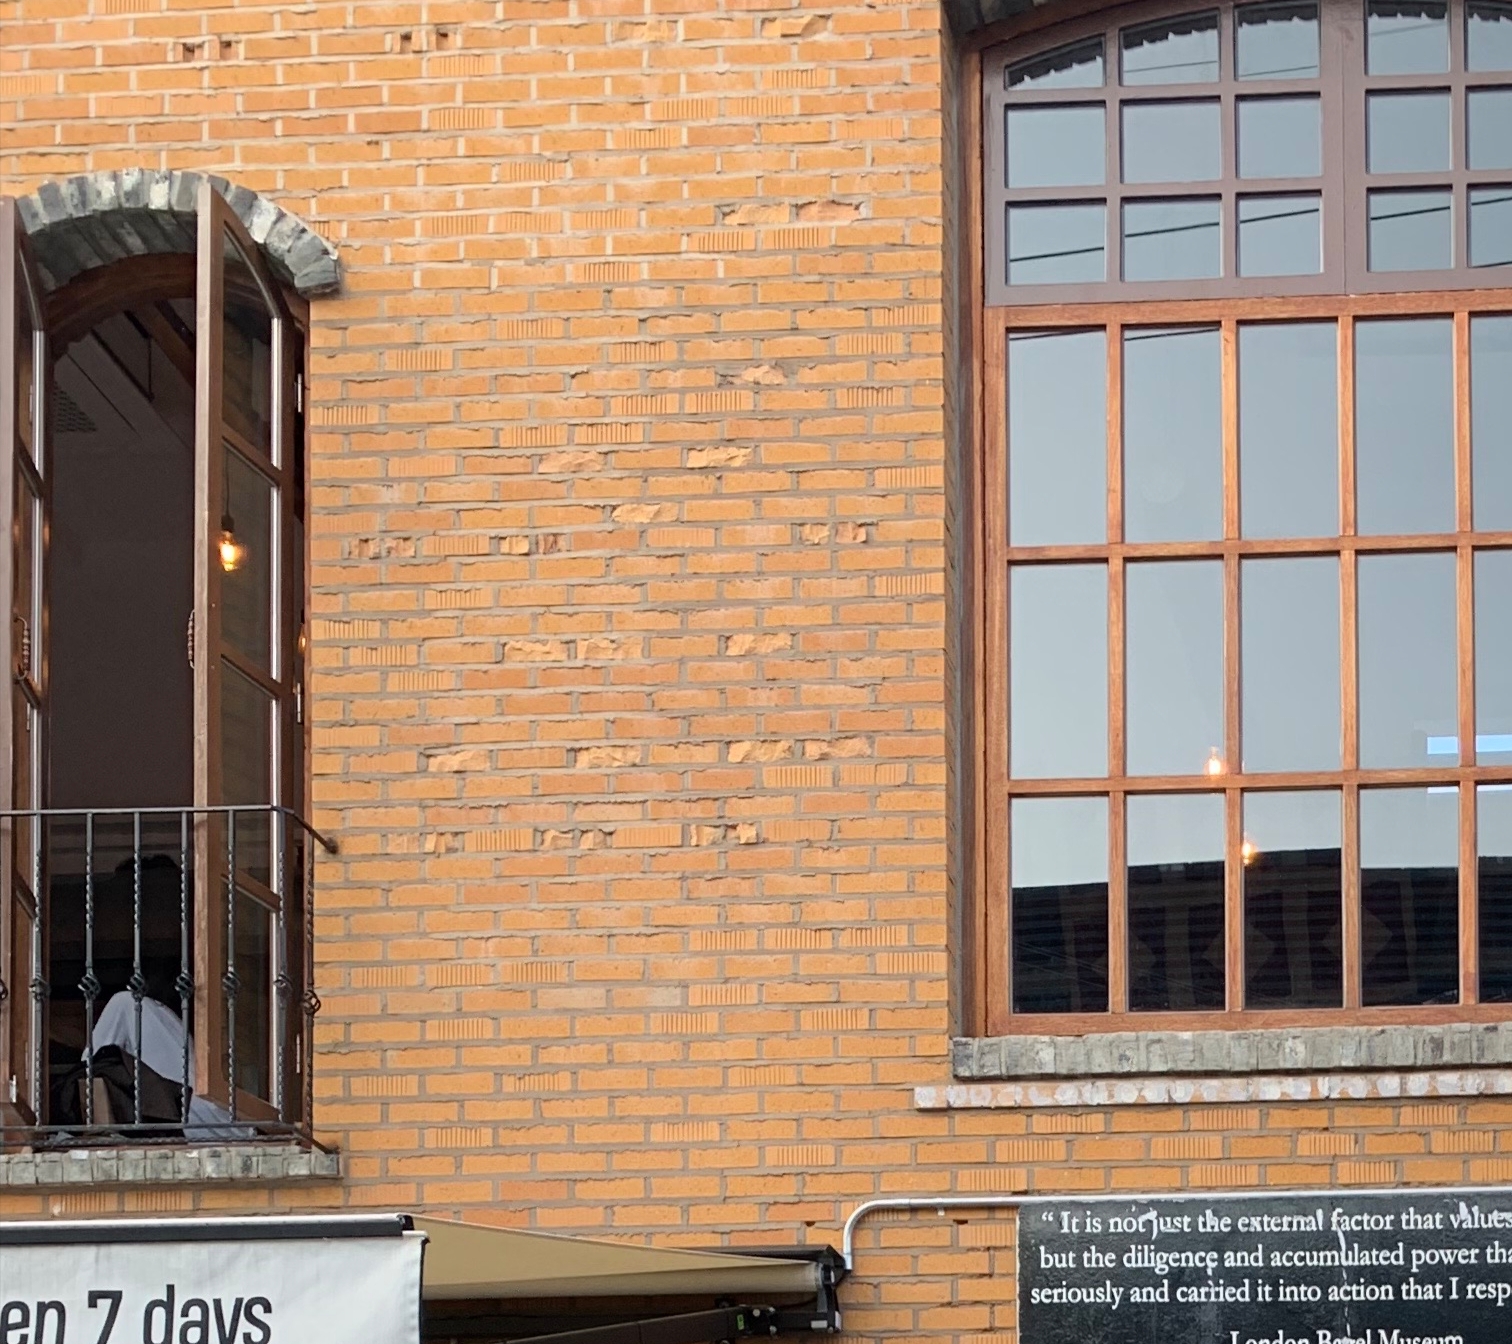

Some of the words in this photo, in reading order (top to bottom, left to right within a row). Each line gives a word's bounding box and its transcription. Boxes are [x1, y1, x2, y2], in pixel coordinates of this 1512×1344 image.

[1085, 1211, 1102, 1233] is
[1198, 1209, 1231, 1233] the
[1237, 1209, 1323, 1233] external
[1331, 1207, 1394, 1232] factor
[1400, 1206, 1443, 1230] that
[1039, 1246, 1076, 1269] but
[1082, 1245, 1116, 1268] the
[1123, 1245, 1218, 1275] diligence
[1223, 1244, 1263, 1267] and
[1270, 1243, 1404, 1267] accumulated
[1411, 1248, 1479, 1272] power
[1031, 1279, 1124, 1310] seriously
[1130, 1279, 1170, 1303] and
[1176, 1279, 1250, 1303] carried
[1256, 1279, 1273, 1302] it
[1278, 1279, 1321, 1302] into
[1328, 1278, 1393, 1302] action
[1401, 1278, 1443, 1300] that
[1449, 1277, 1459, 1300] I
